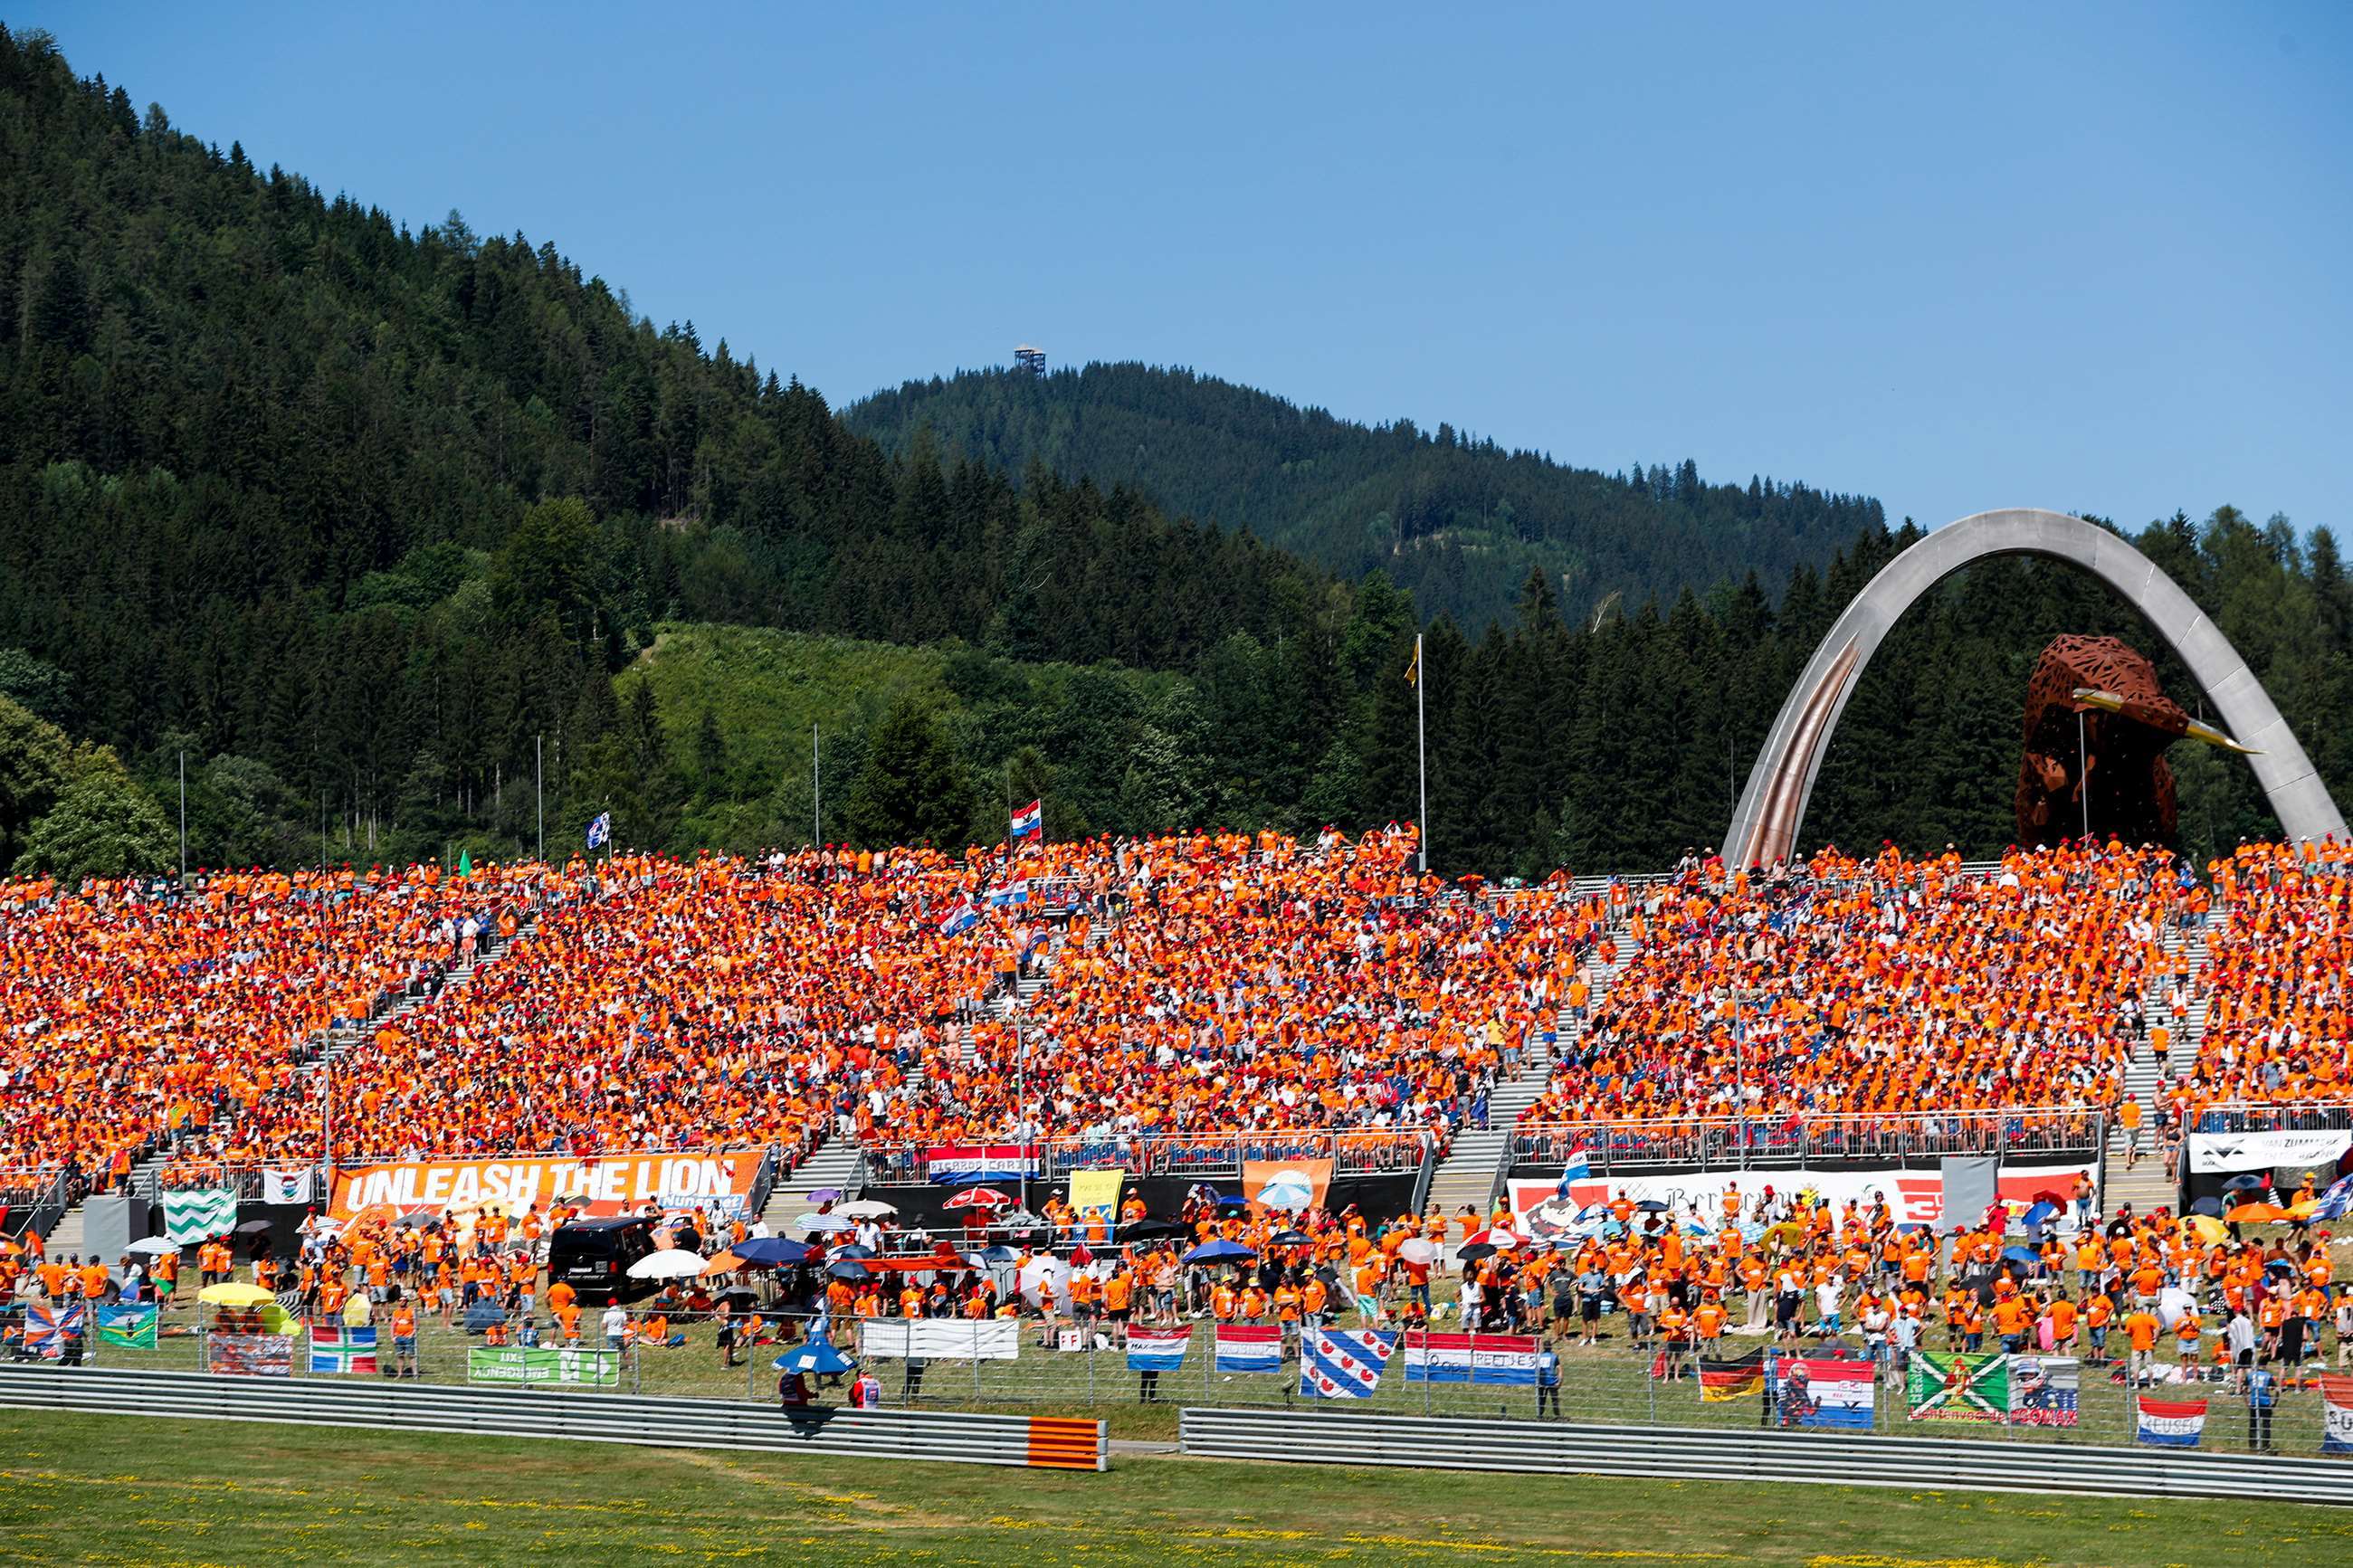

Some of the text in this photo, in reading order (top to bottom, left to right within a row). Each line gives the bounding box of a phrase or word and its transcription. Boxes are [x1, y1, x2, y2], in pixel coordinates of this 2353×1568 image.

[347, 1158, 734, 1212] UNLEASH THE LION
[662, 1194, 739, 1210] Nunspet
[474, 1365, 550, 1379] EMERGENCY
